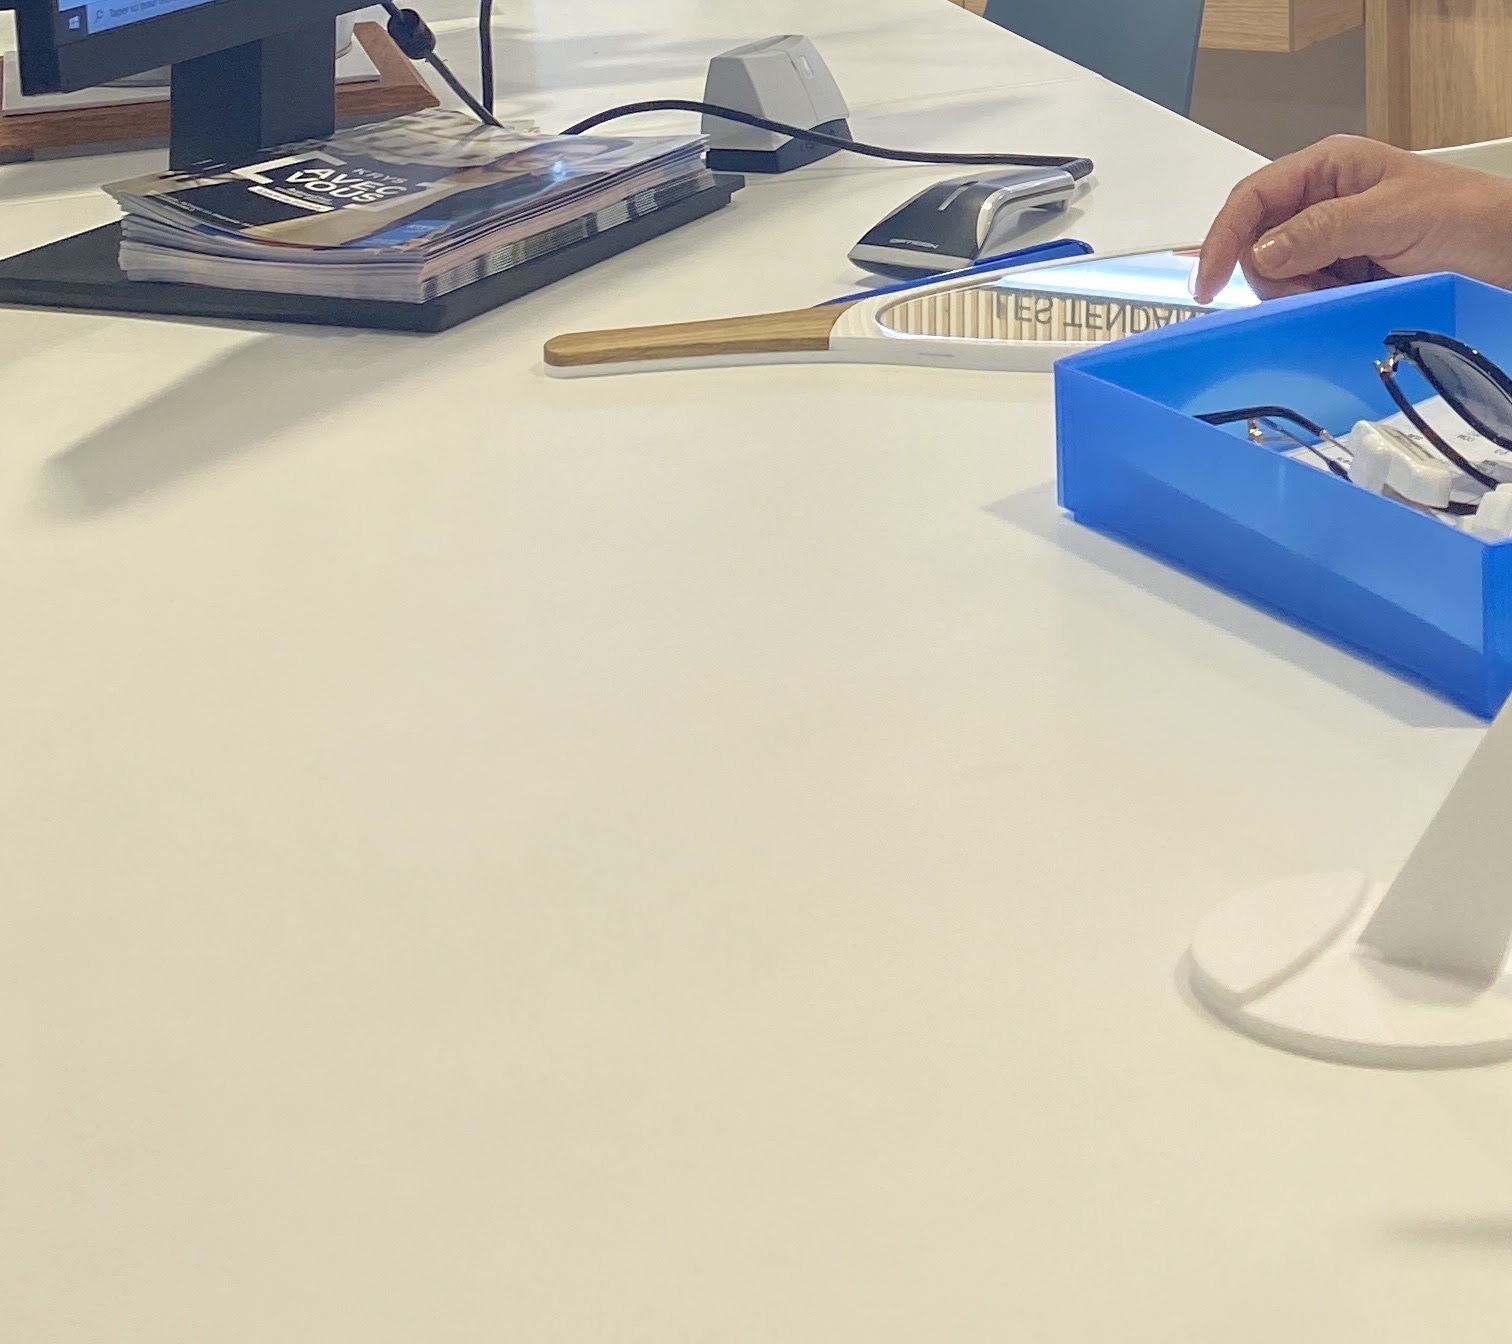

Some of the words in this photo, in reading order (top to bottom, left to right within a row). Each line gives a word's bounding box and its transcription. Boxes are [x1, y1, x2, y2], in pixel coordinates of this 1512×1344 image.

[285, 171, 385, 202] VOUS
[303, 168, 407, 195] AVEC
[351, 167, 408, 184] KRYS
